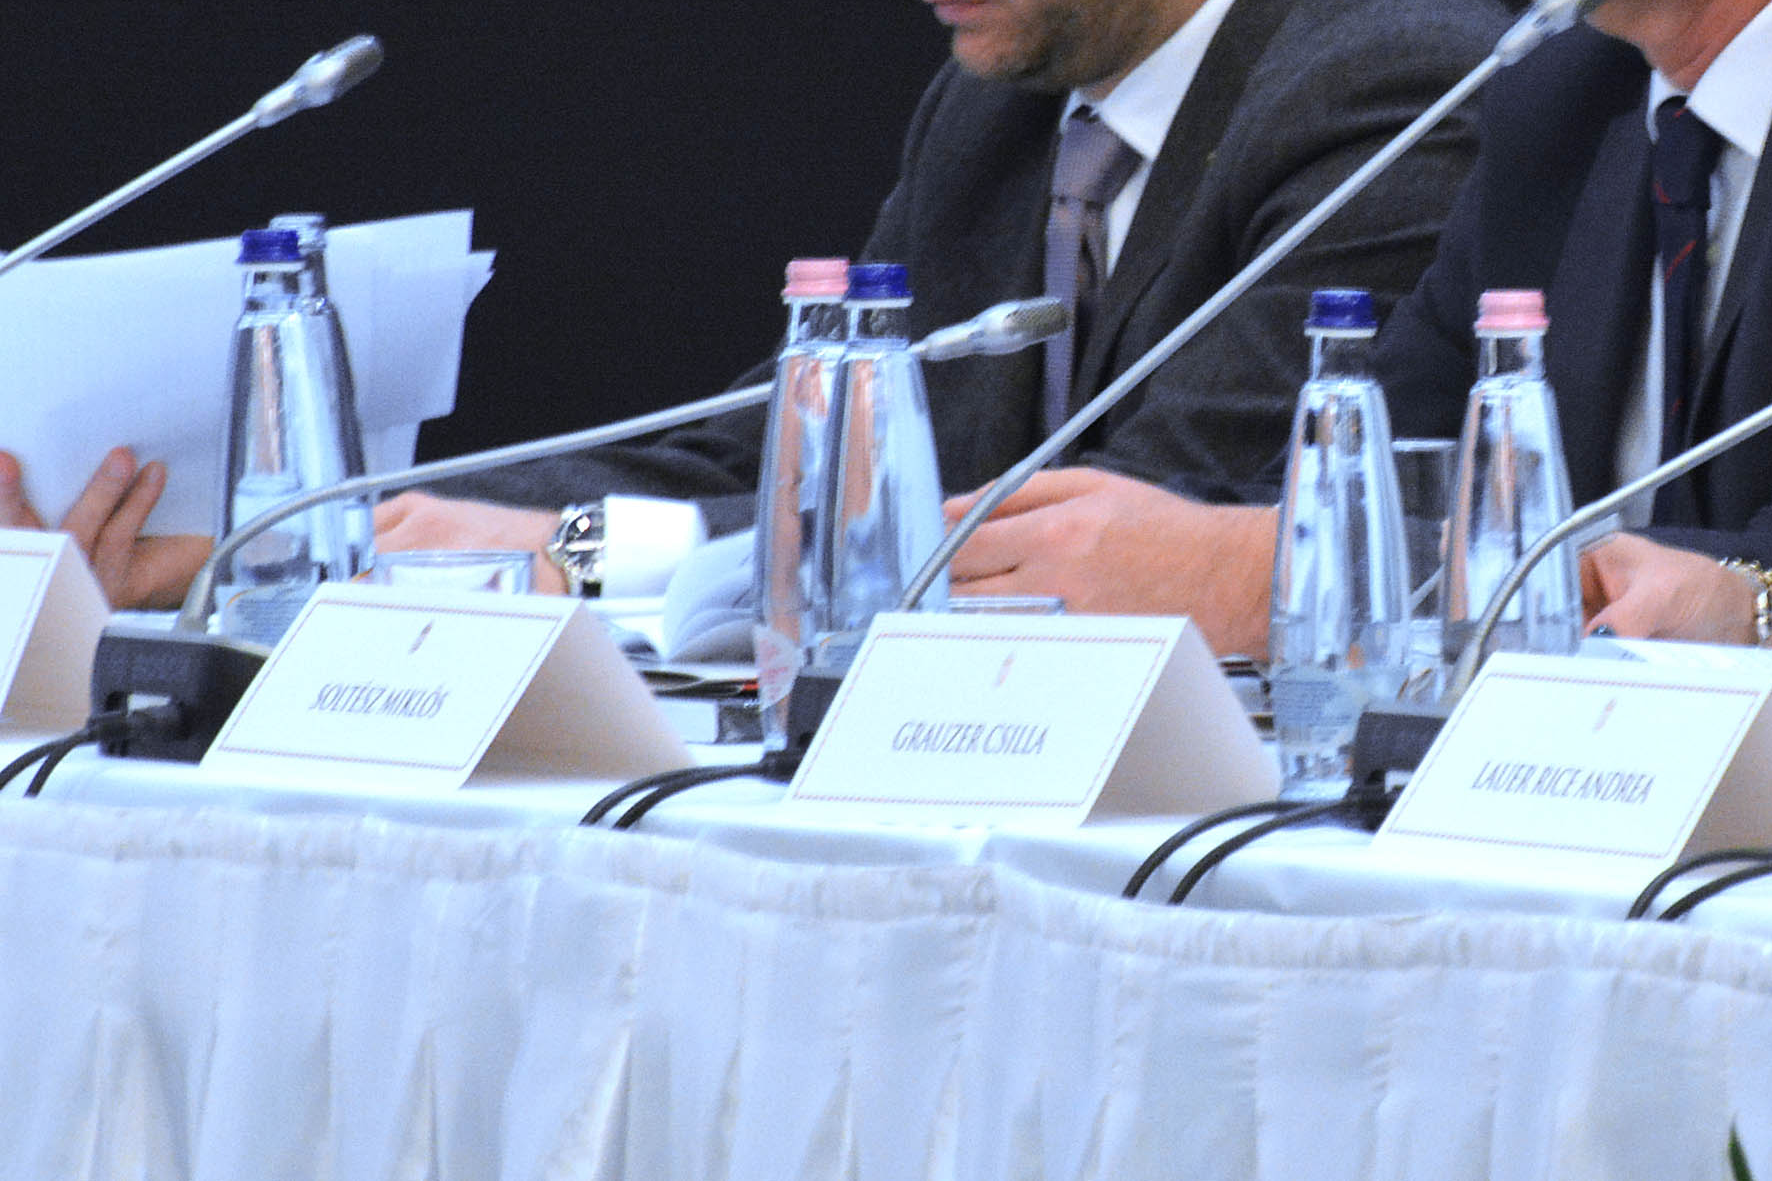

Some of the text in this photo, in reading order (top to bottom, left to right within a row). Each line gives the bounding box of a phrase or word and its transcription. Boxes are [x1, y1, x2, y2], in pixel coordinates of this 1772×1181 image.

[892, 721, 1050, 755] GRAUZER CSILLA
[1471, 760, 1656, 805] LAUER RICE ANDREA
